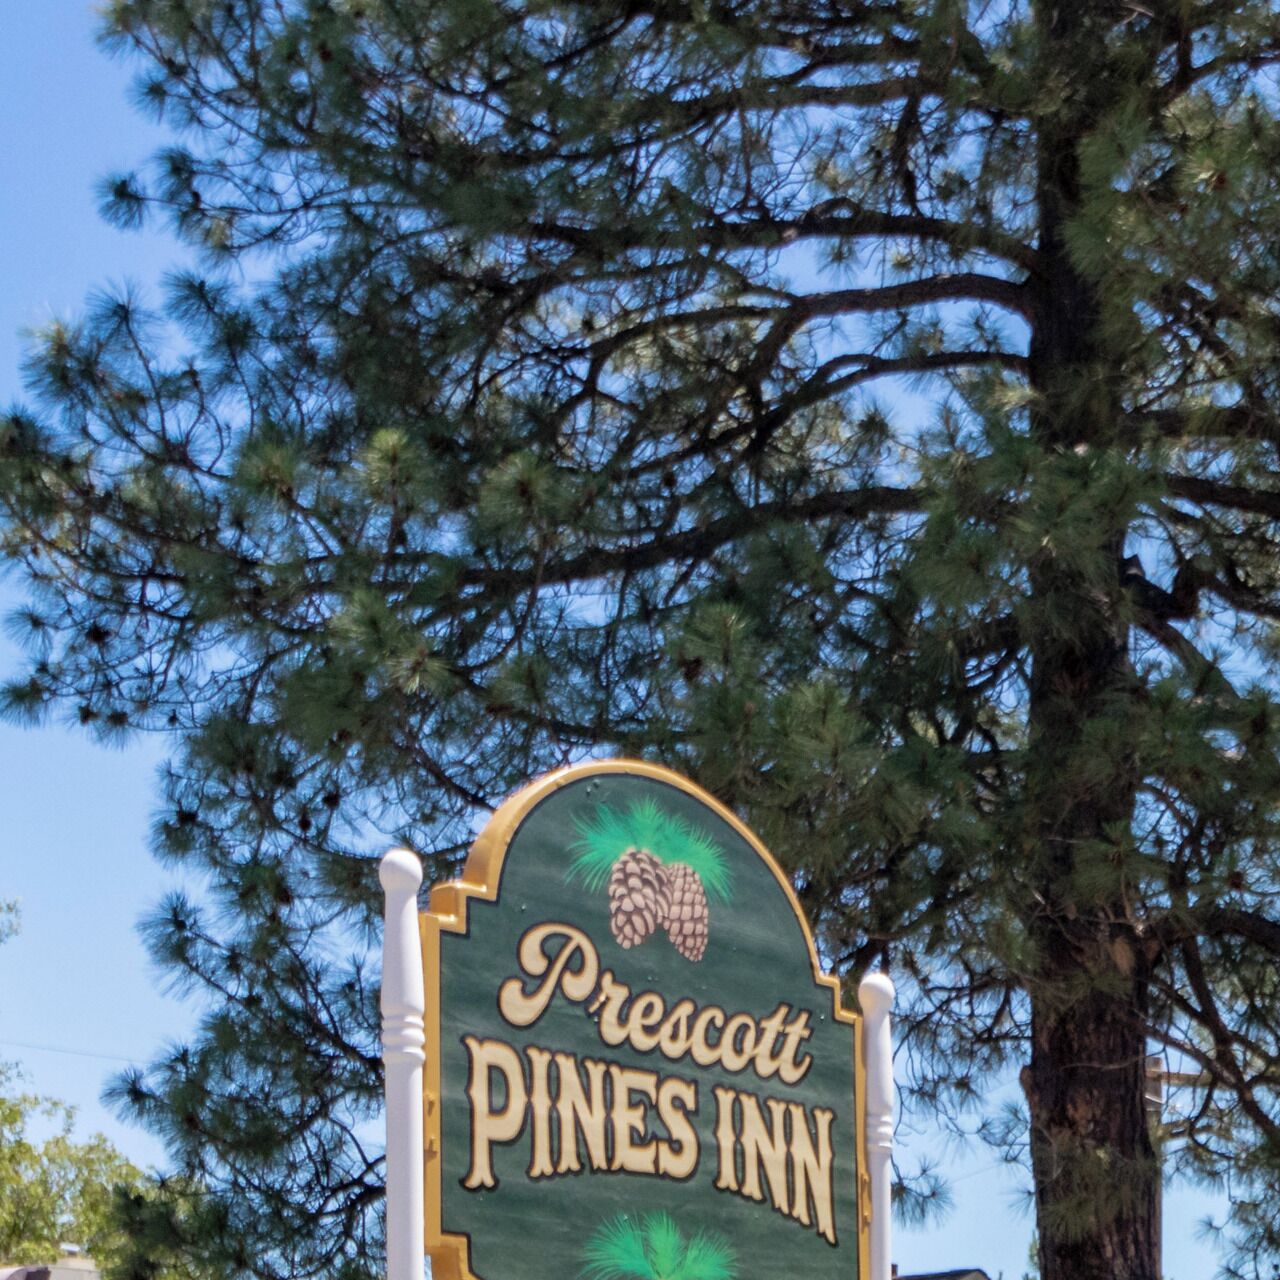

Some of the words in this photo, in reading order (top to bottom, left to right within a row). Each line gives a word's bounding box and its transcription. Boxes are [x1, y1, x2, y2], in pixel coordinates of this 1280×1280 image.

[498, 921, 812, 1085] Prescott
[460, 1035, 701, 1191] PINES
[712, 1086, 838, 1247] INN
